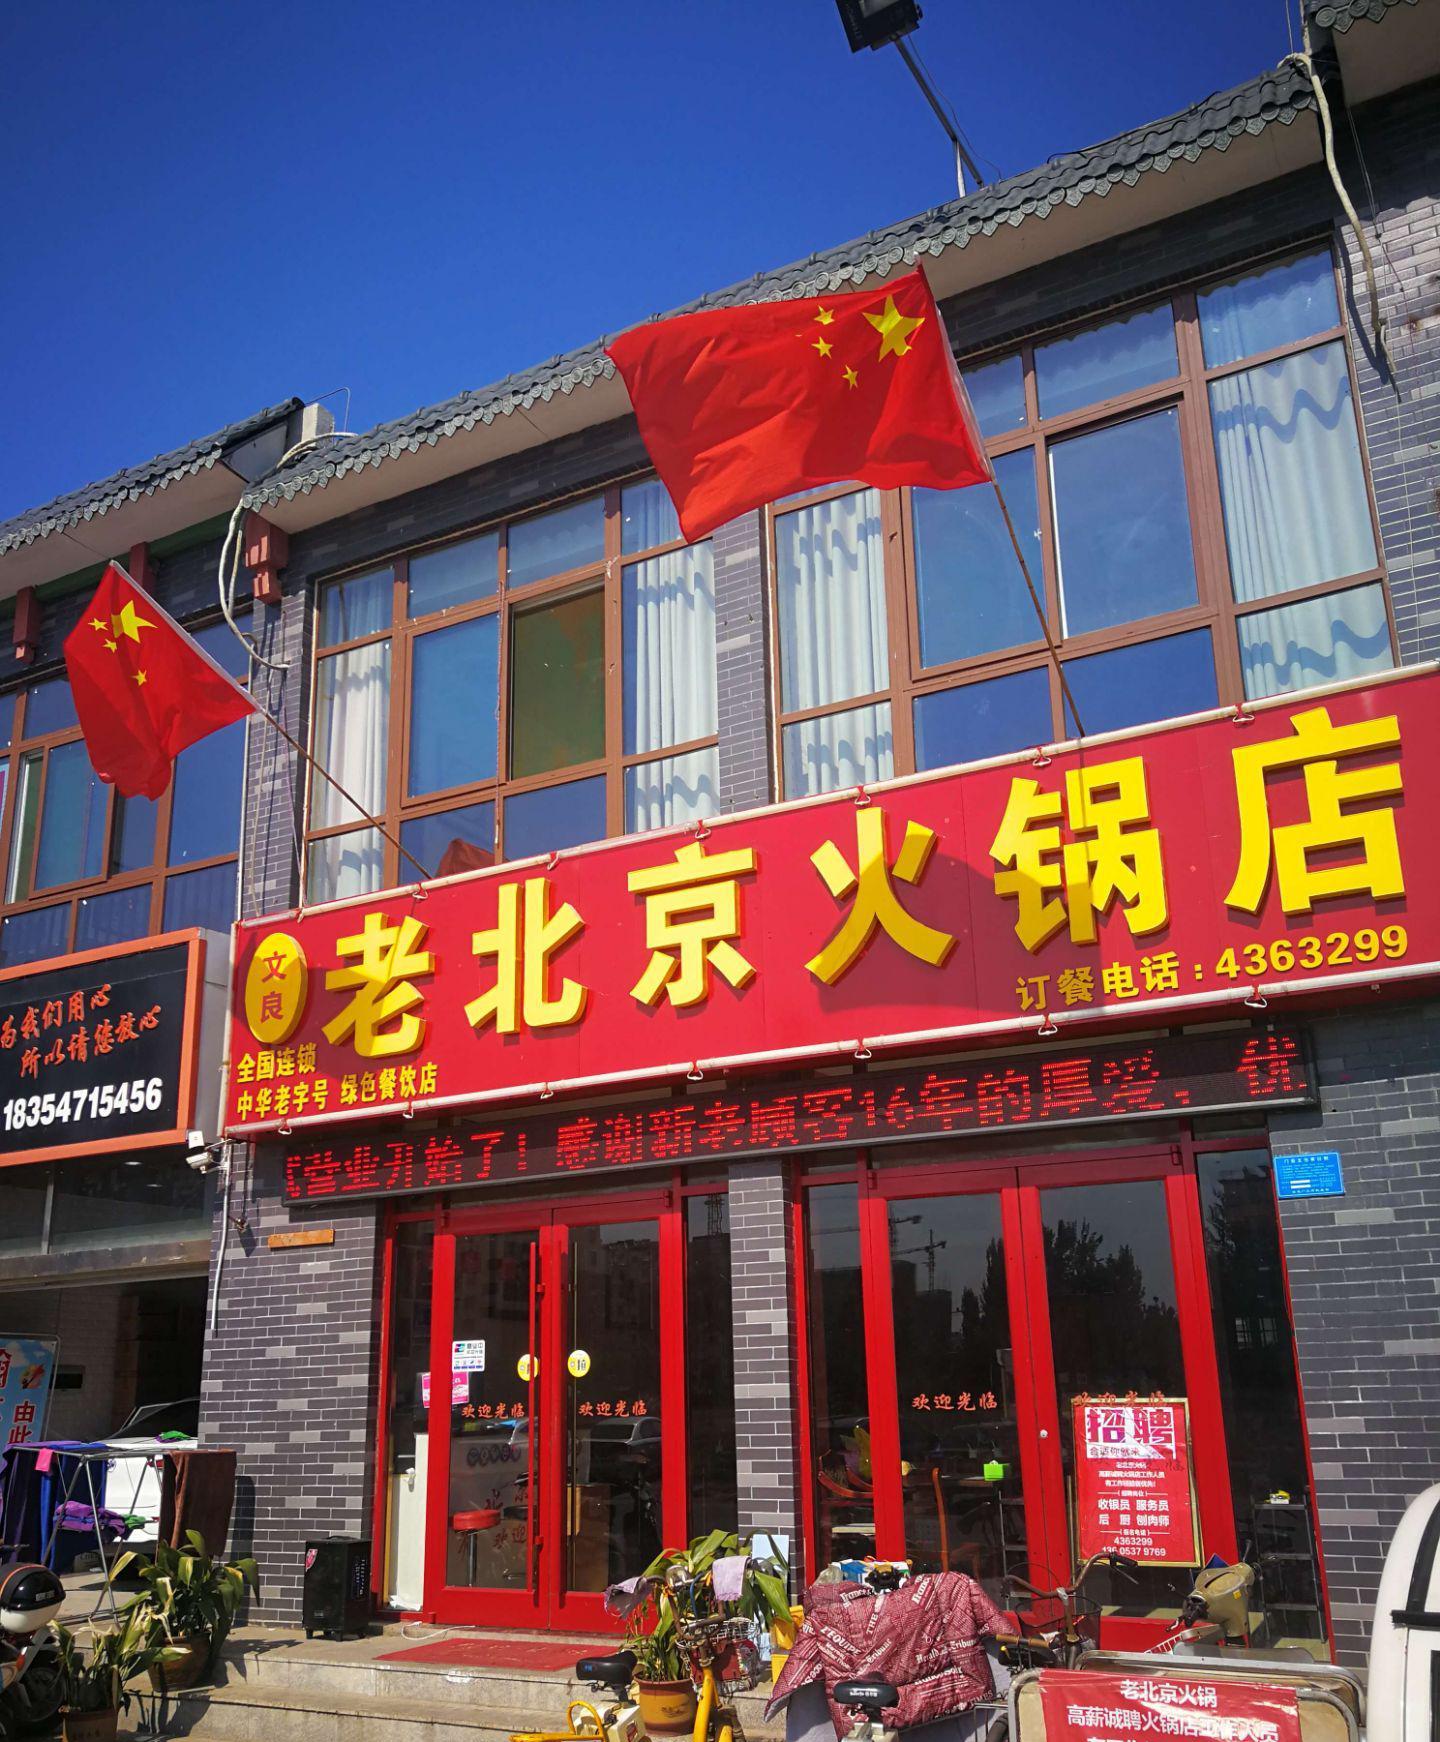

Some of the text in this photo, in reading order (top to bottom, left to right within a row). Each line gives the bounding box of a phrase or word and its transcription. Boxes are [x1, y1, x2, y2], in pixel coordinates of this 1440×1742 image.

[322, 707, 1406, 1059] 老北京火锅店
[260, 951, 287, 1024] 文良
[236, 1042, 317, 1083] 全国连锁
[3, 1077, 163, 1131] 18354715456
[236, 1062, 438, 1121] 中华老字号 绿色餐饮店
[461, 1402, 525, 1419] 欢迎光临
[579, 1400, 648, 1417] 欢迎光临
[912, 1391, 998, 1411] 欢迎光临
[1087, 1408, 1173, 1444] 招聘
[1098, 1499, 1169, 1511] 收银员 服务员
[1114, 1537, 1153, 1545] 4363299
[1120, 1547, 1141, 1555] 0537
[1120, 1680, 1217, 1707] 老北京火锅
